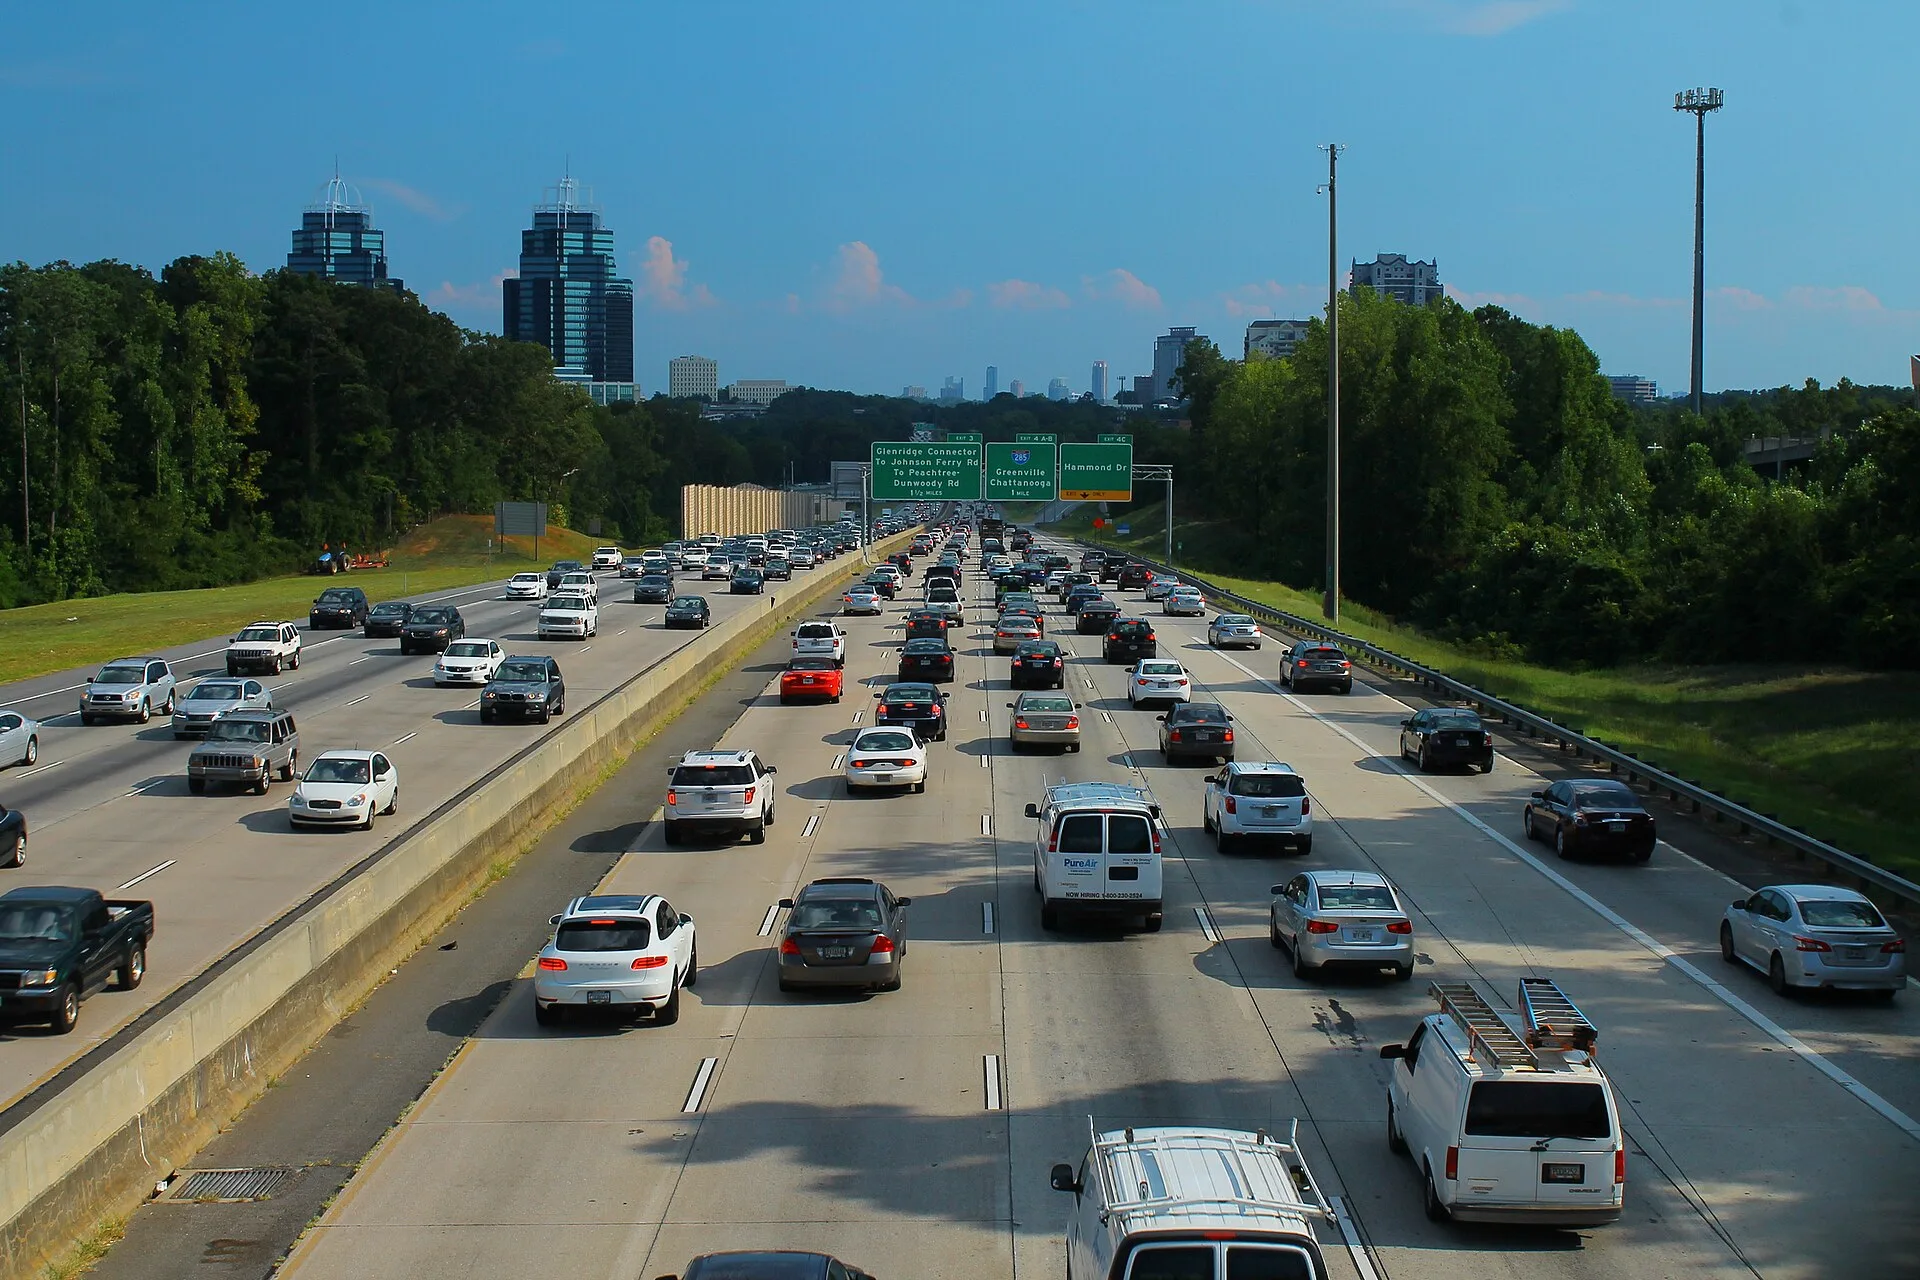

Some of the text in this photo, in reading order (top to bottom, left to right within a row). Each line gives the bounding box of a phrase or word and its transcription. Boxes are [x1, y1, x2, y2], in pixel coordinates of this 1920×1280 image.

[876, 448, 923, 456] Glenridge
[936, 459, 962, 467] Ferry
[894, 480, 942, 488] Dunwoody
[990, 478, 1051, 488] Chattanooga
